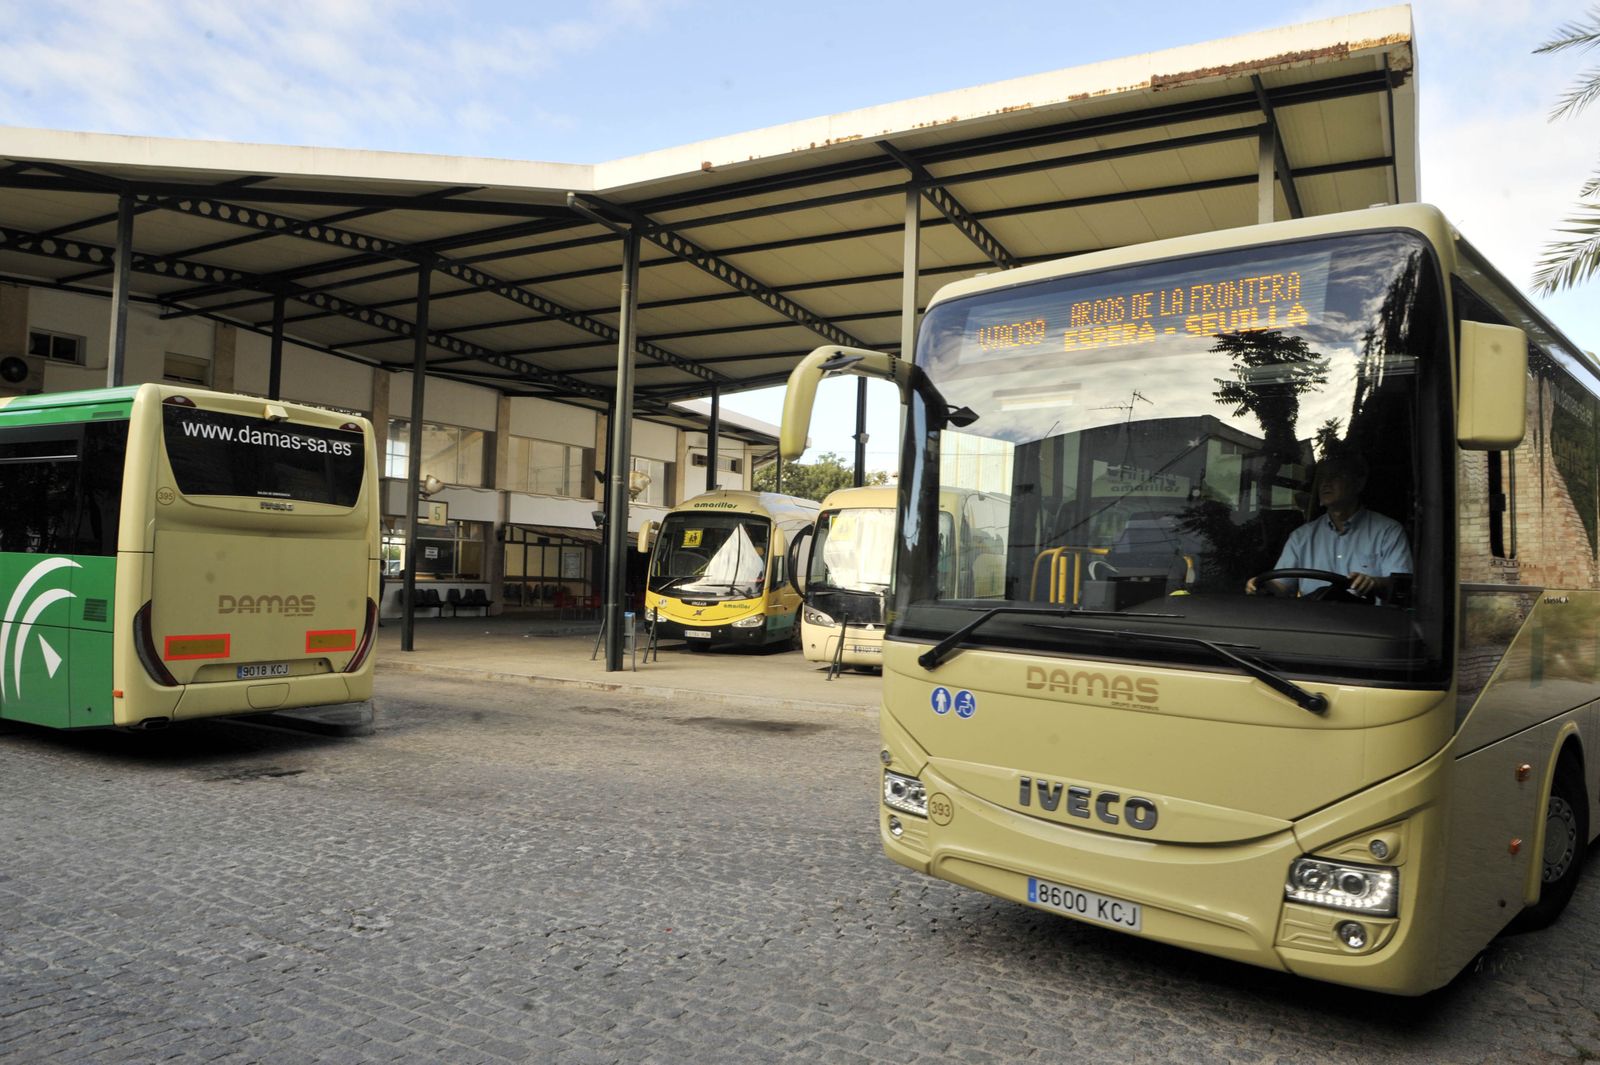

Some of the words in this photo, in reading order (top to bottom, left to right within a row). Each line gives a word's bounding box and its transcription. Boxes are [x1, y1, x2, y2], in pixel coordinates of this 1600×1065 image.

[1071, 296, 1125, 328] ARCOS
[1131, 292, 1154, 319] DE
[1160, 287, 1184, 316] LA
[1190, 271, 1301, 313] FRONTERA
[1063, 320, 1157, 352] ESPERA
[1184, 301, 1309, 338] SEVILLA
[181, 420, 353, 457] www.damas-sa.es
[434, 506, 441, 520] 5
[693, 501, 739, 509] amarillos
[217, 594, 317, 614] DAMAS
[243, 665, 268, 677] 9018
[270, 664, 289, 675] KCJ
[1026, 664, 1160, 704] DAMAS
[931, 801, 951, 818] 393
[1018, 775, 1159, 831] IVECO
[1039, 884, 1087, 913] 8600
[1097, 898, 1137, 927] KCJ
